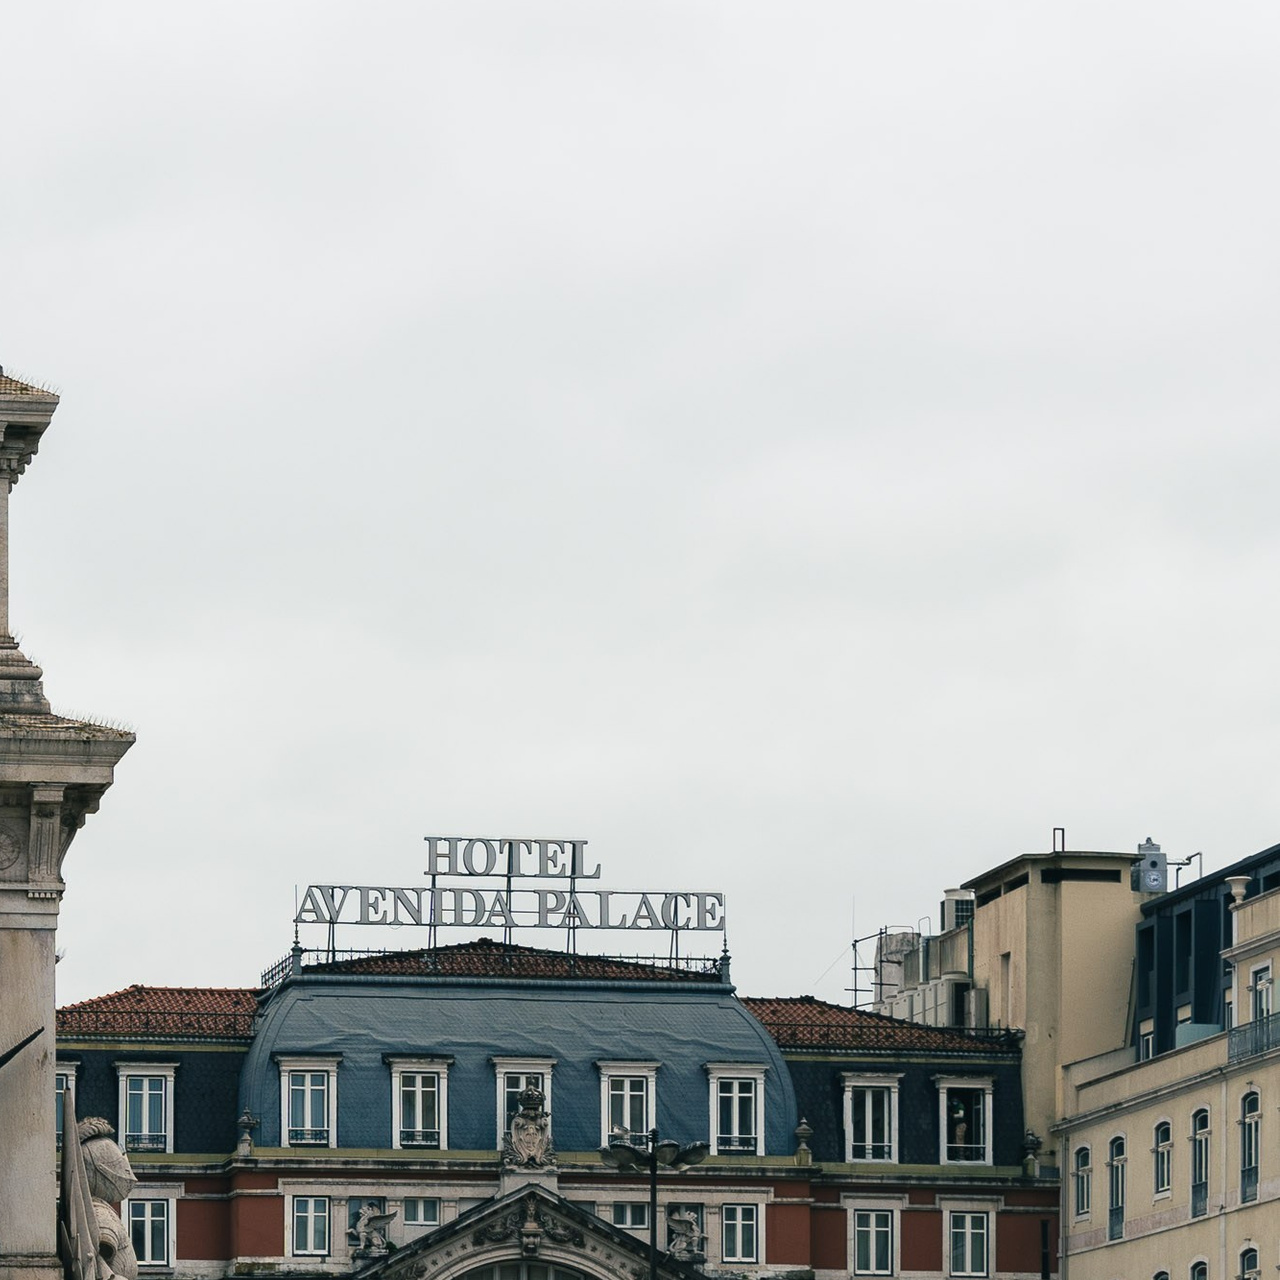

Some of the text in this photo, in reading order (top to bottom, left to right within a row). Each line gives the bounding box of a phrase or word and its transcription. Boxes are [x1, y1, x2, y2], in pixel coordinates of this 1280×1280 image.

[424, 836, 601, 879] HOTEL
[294, 885, 725, 931] AVENIDA PALACE
